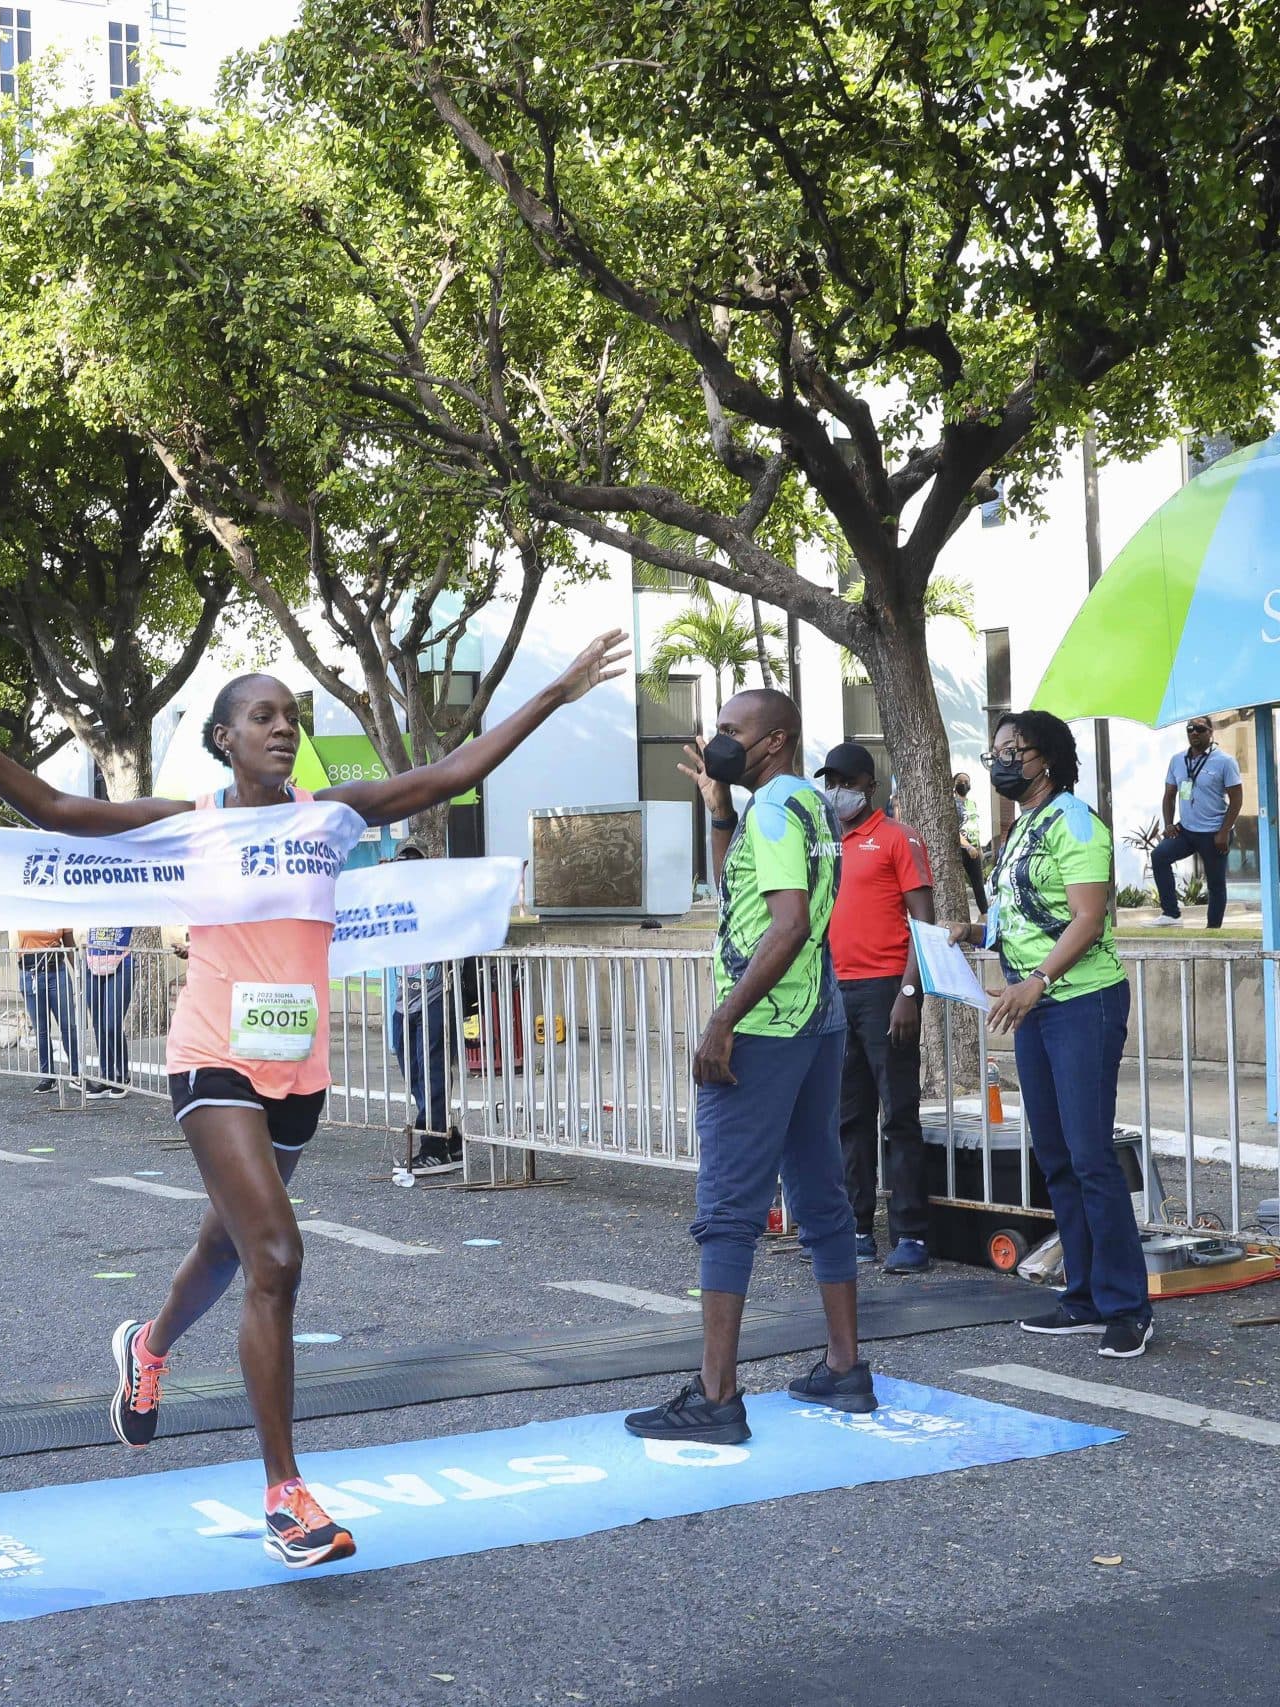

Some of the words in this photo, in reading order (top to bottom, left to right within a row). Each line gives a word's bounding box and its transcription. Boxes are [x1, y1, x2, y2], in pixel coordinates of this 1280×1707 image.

[328, 764, 388, 781] 888-S
[24, 855, 34, 885] SIGMA
[241, 846, 250, 876] SIGMA
[63, 866, 149, 885] CORPORATE
[152, 864, 185, 882] RUN
[375, 901, 417, 919] SIGMA
[394, 918, 418, 933] RUN
[246, 1009, 308, 1028] 50015
